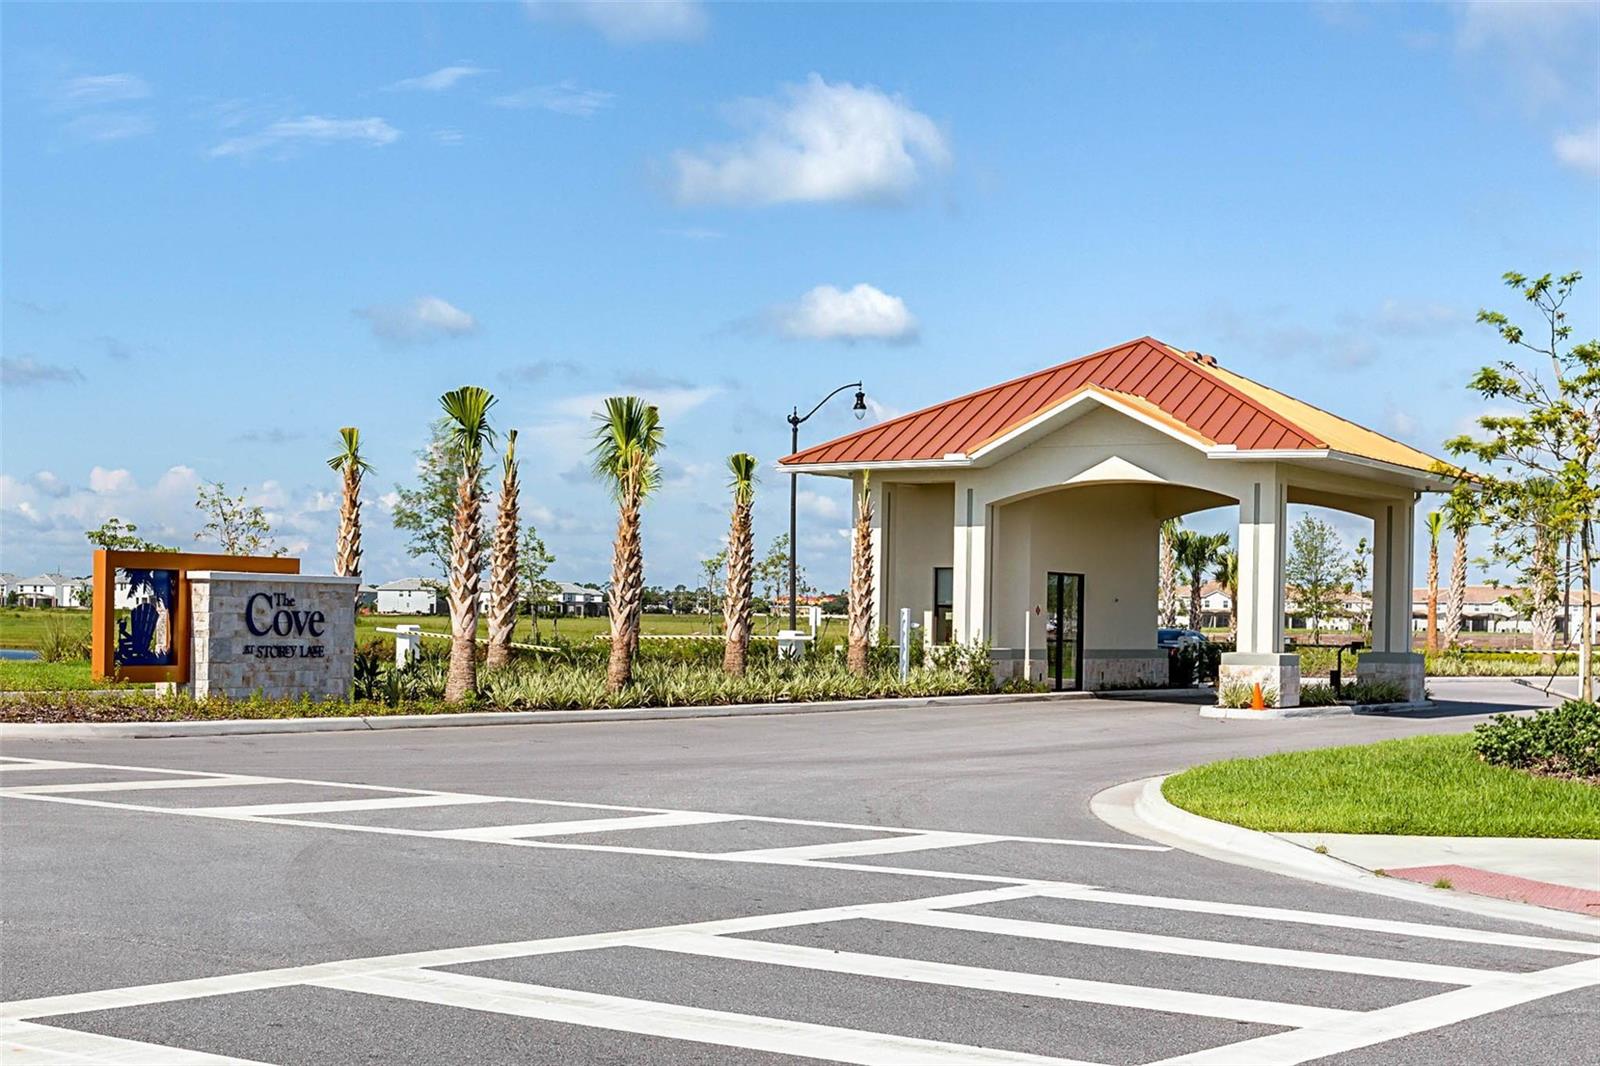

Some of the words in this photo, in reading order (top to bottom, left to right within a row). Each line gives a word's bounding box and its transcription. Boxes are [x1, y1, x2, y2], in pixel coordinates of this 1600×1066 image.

[273, 592, 295, 606] The
[245, 592, 325, 637] Cove
[255, 645, 297, 658] STOREY
